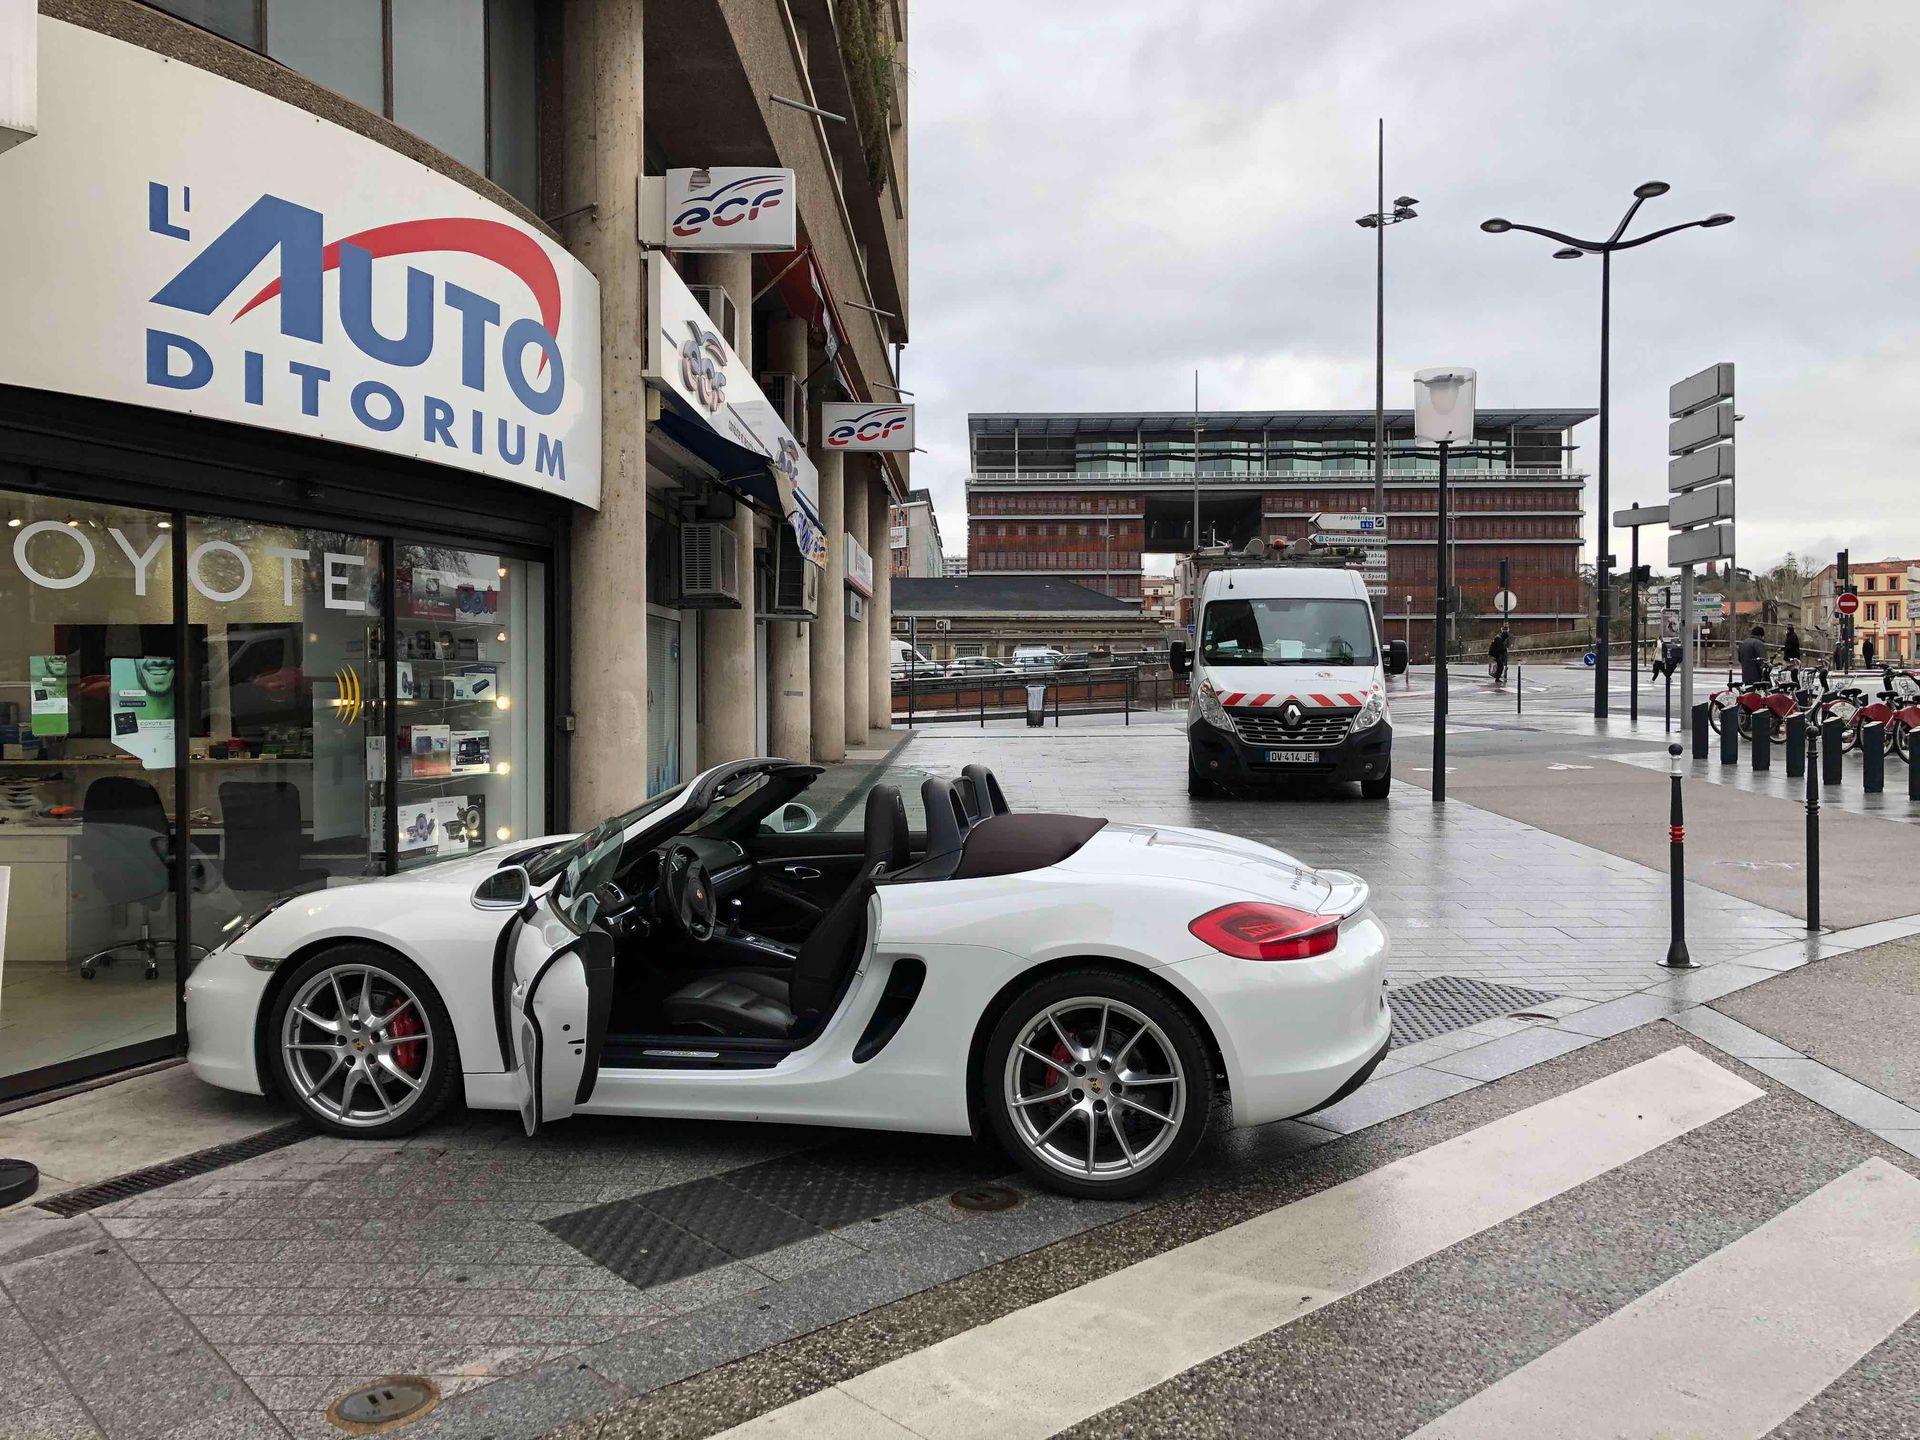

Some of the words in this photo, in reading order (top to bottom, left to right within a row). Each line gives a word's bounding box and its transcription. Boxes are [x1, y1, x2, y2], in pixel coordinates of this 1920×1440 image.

[672, 188, 784, 237] ecf
[146, 328, 566, 482] DITORIUM
[827, 416, 907, 446] ecf
[1272, 752, 1313, 762] DV-414-JE
